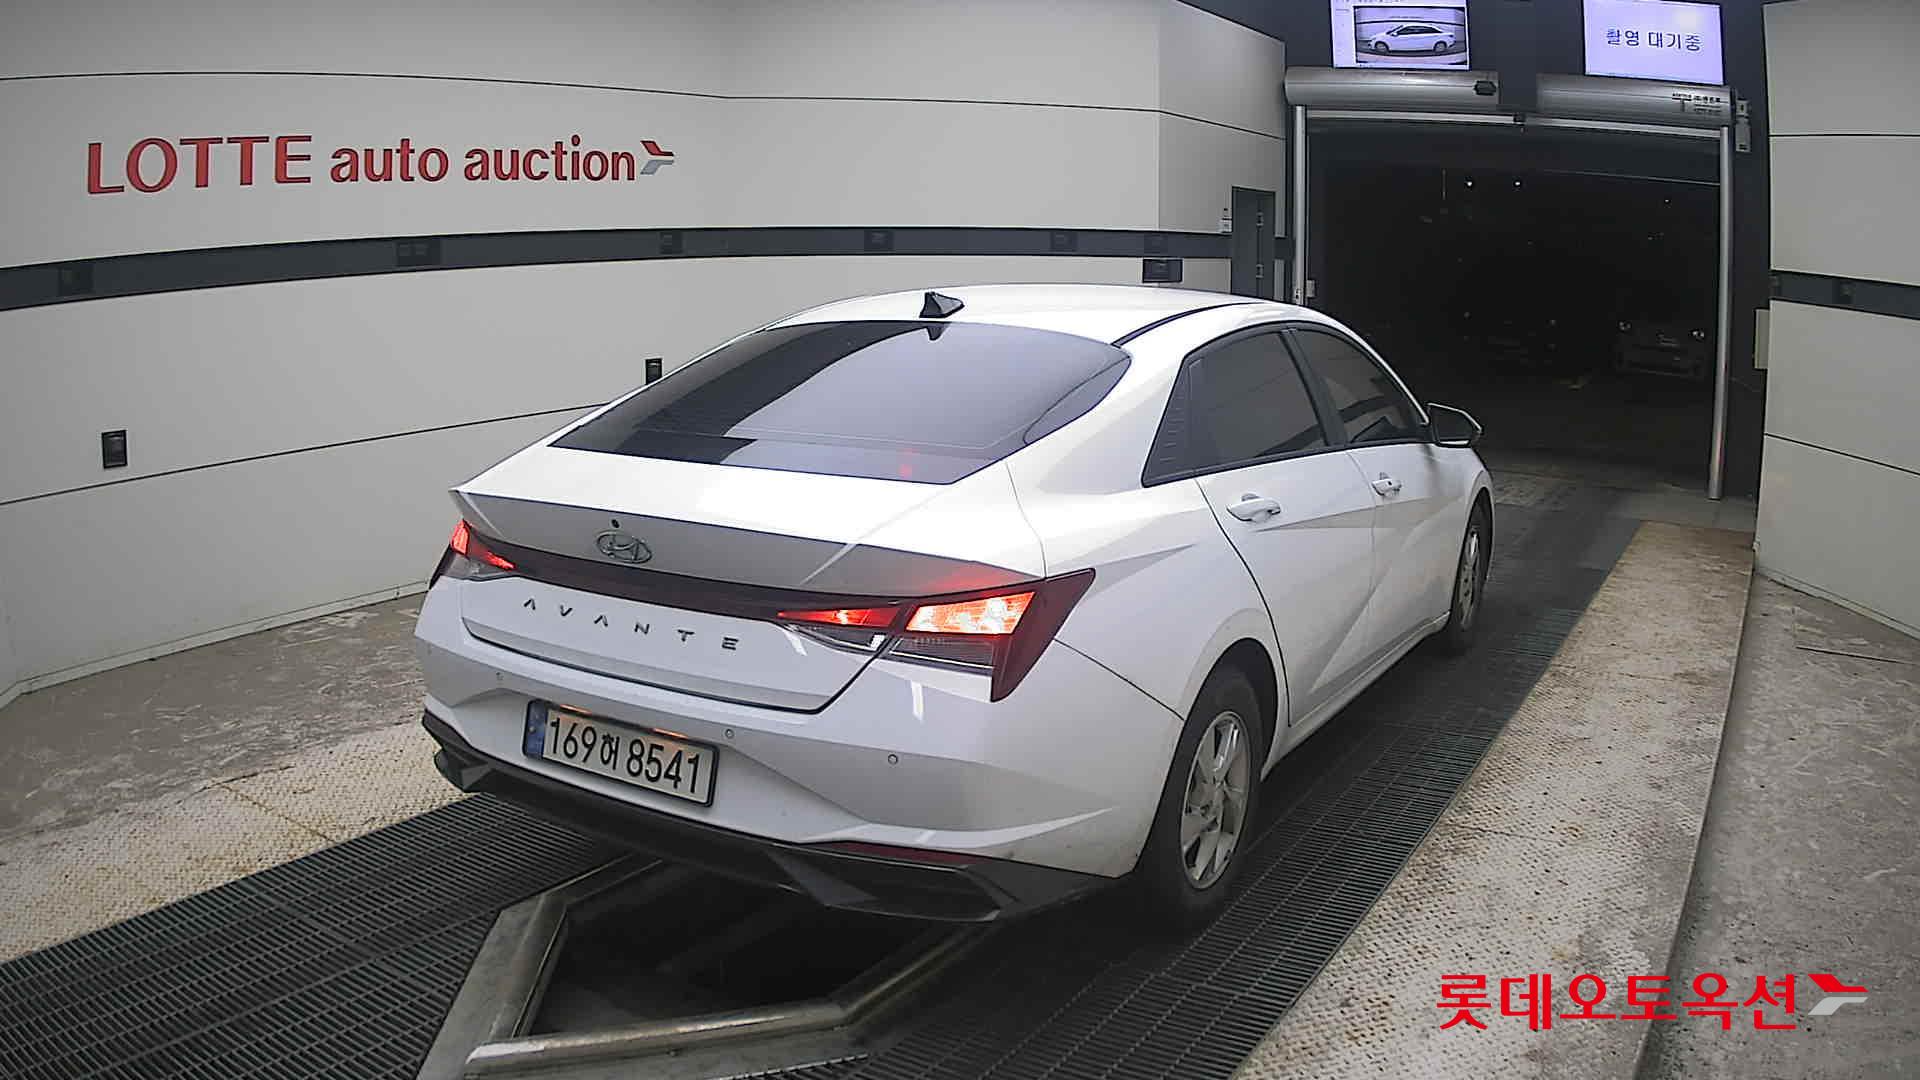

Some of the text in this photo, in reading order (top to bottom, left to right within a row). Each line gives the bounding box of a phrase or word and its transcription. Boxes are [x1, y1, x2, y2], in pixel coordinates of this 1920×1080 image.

[1606, 28, 1640, 47] 촬영
[87, 134, 636, 195] LOTTE auto auction
[523, 598, 739, 651] AVANTE
